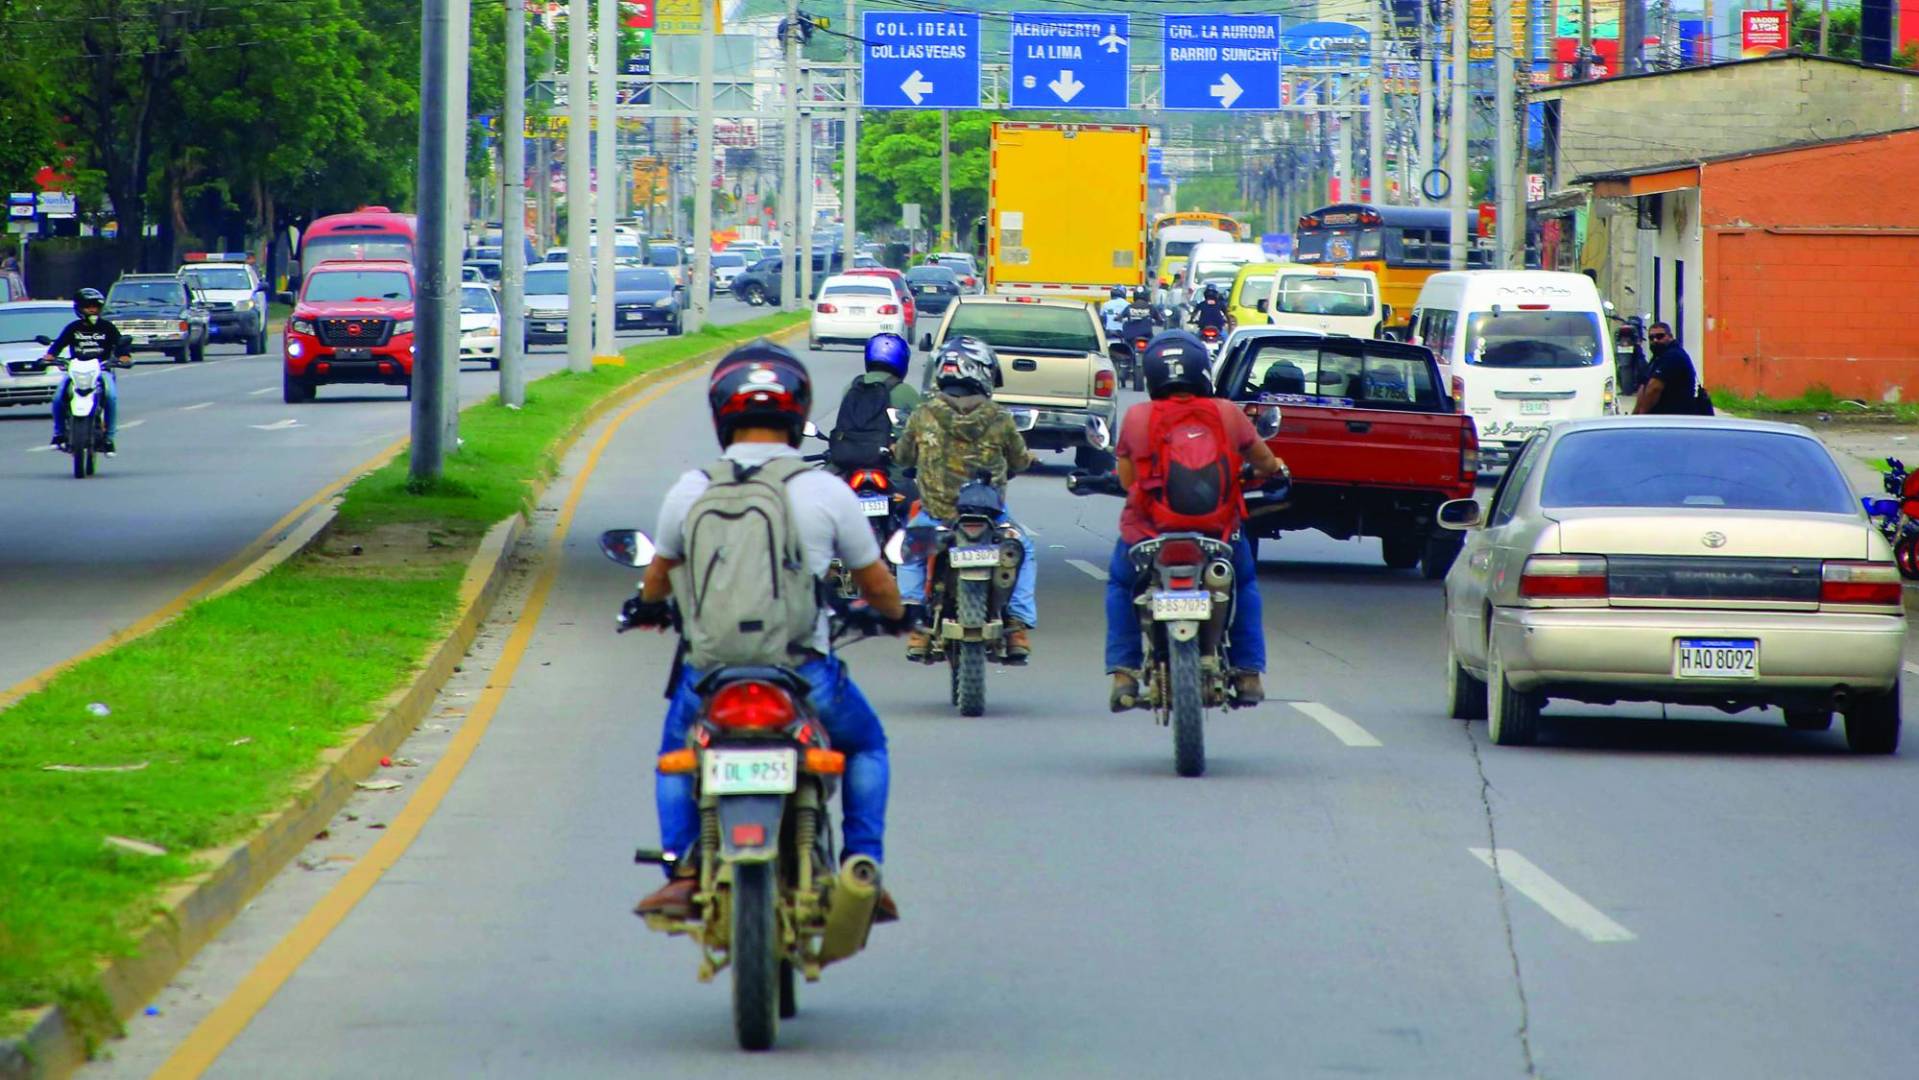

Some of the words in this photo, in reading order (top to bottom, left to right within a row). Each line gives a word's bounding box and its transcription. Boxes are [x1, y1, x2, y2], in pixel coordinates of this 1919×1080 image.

[917, 22, 968, 36] IDEAL
[1013, 22, 1101, 37] AEROPUERTO
[1201, 25, 1218, 39] LA
[1221, 25, 1275, 39] AURORA
[925, 45, 966, 58] VEGAS
[1027, 45, 1045, 59] LA
[1048, 45, 1082, 60] LIMA
[1170, 47, 1217, 61] BARRIO
[1221, 47, 1279, 62] SUNCERY
